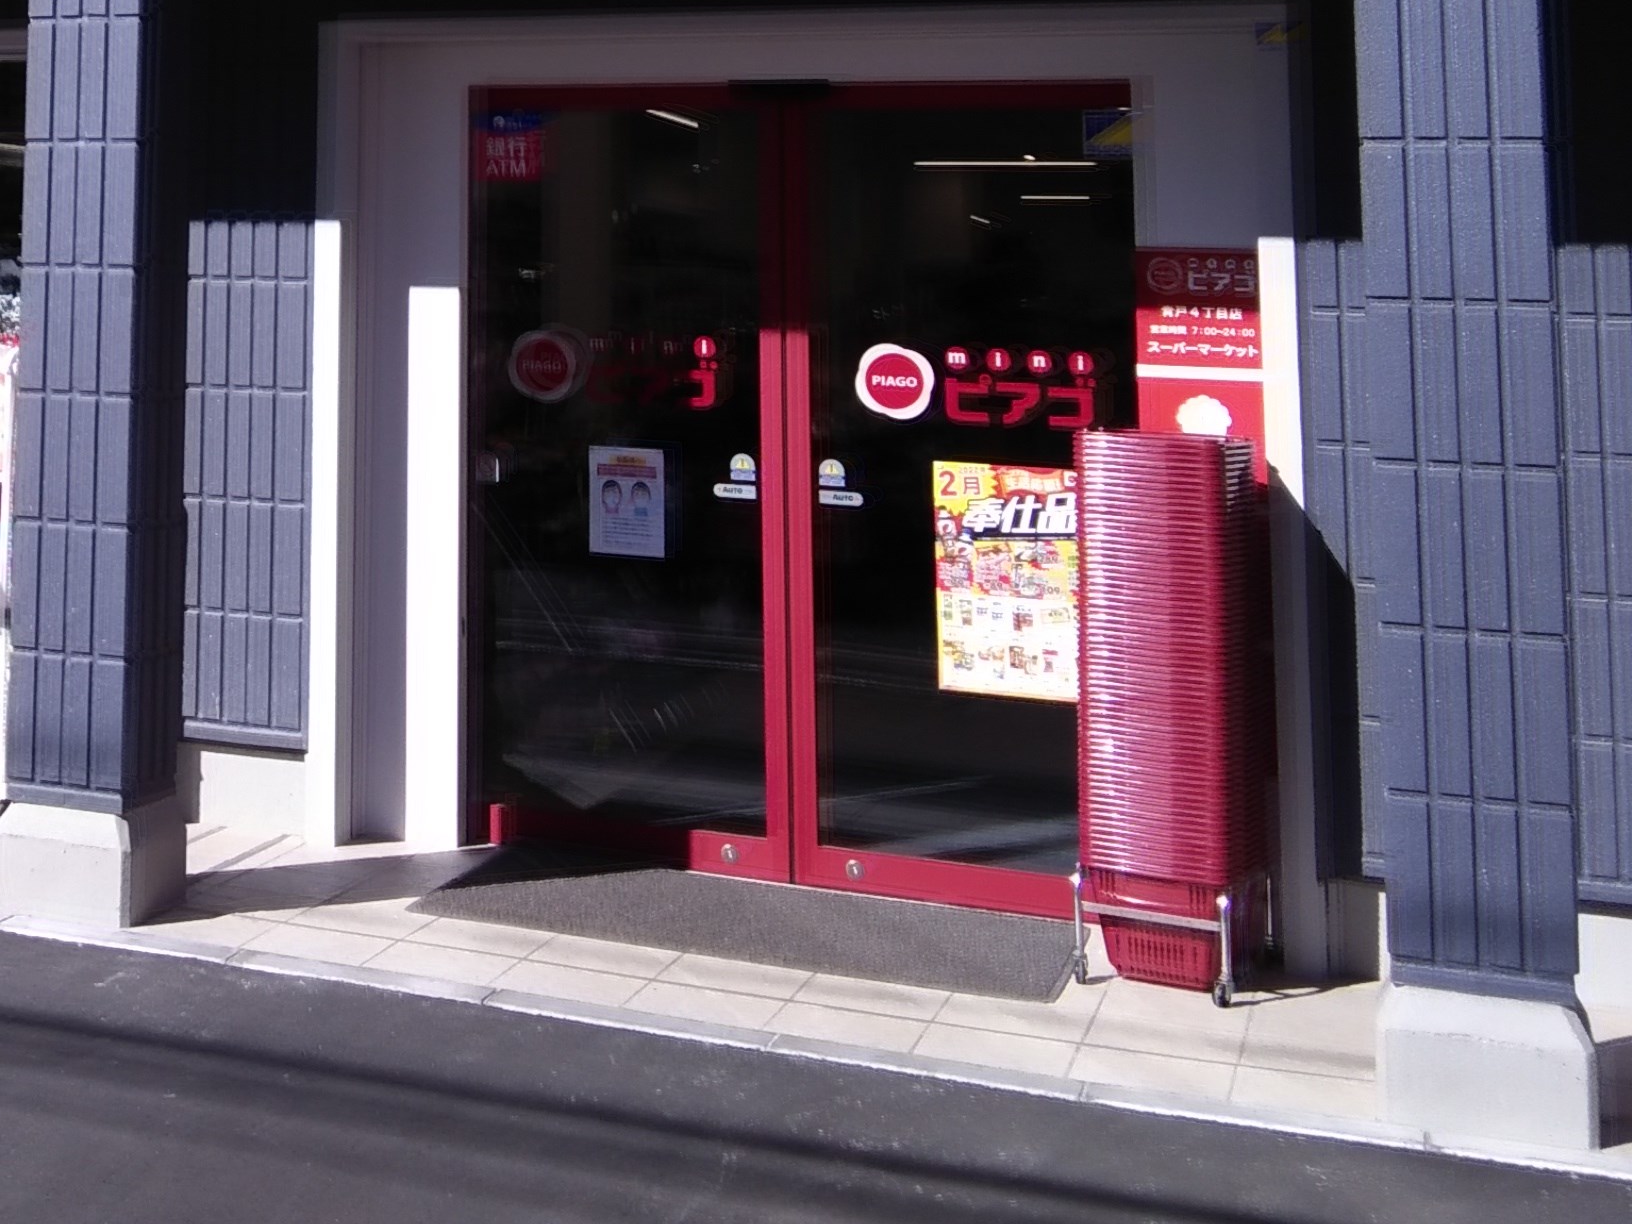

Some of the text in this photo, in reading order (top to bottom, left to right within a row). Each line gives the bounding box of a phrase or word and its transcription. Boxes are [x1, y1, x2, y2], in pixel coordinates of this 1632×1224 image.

[486, 160, 527, 177] ATM
[1146, 341, 1259, 358] スーパーマーケット
[947, 352, 1085, 371] mini
[871, 375, 919, 388] PIAGO
[944, 374, 1096, 428] ピアゴ
[939, 470, 981, 496] 2月
